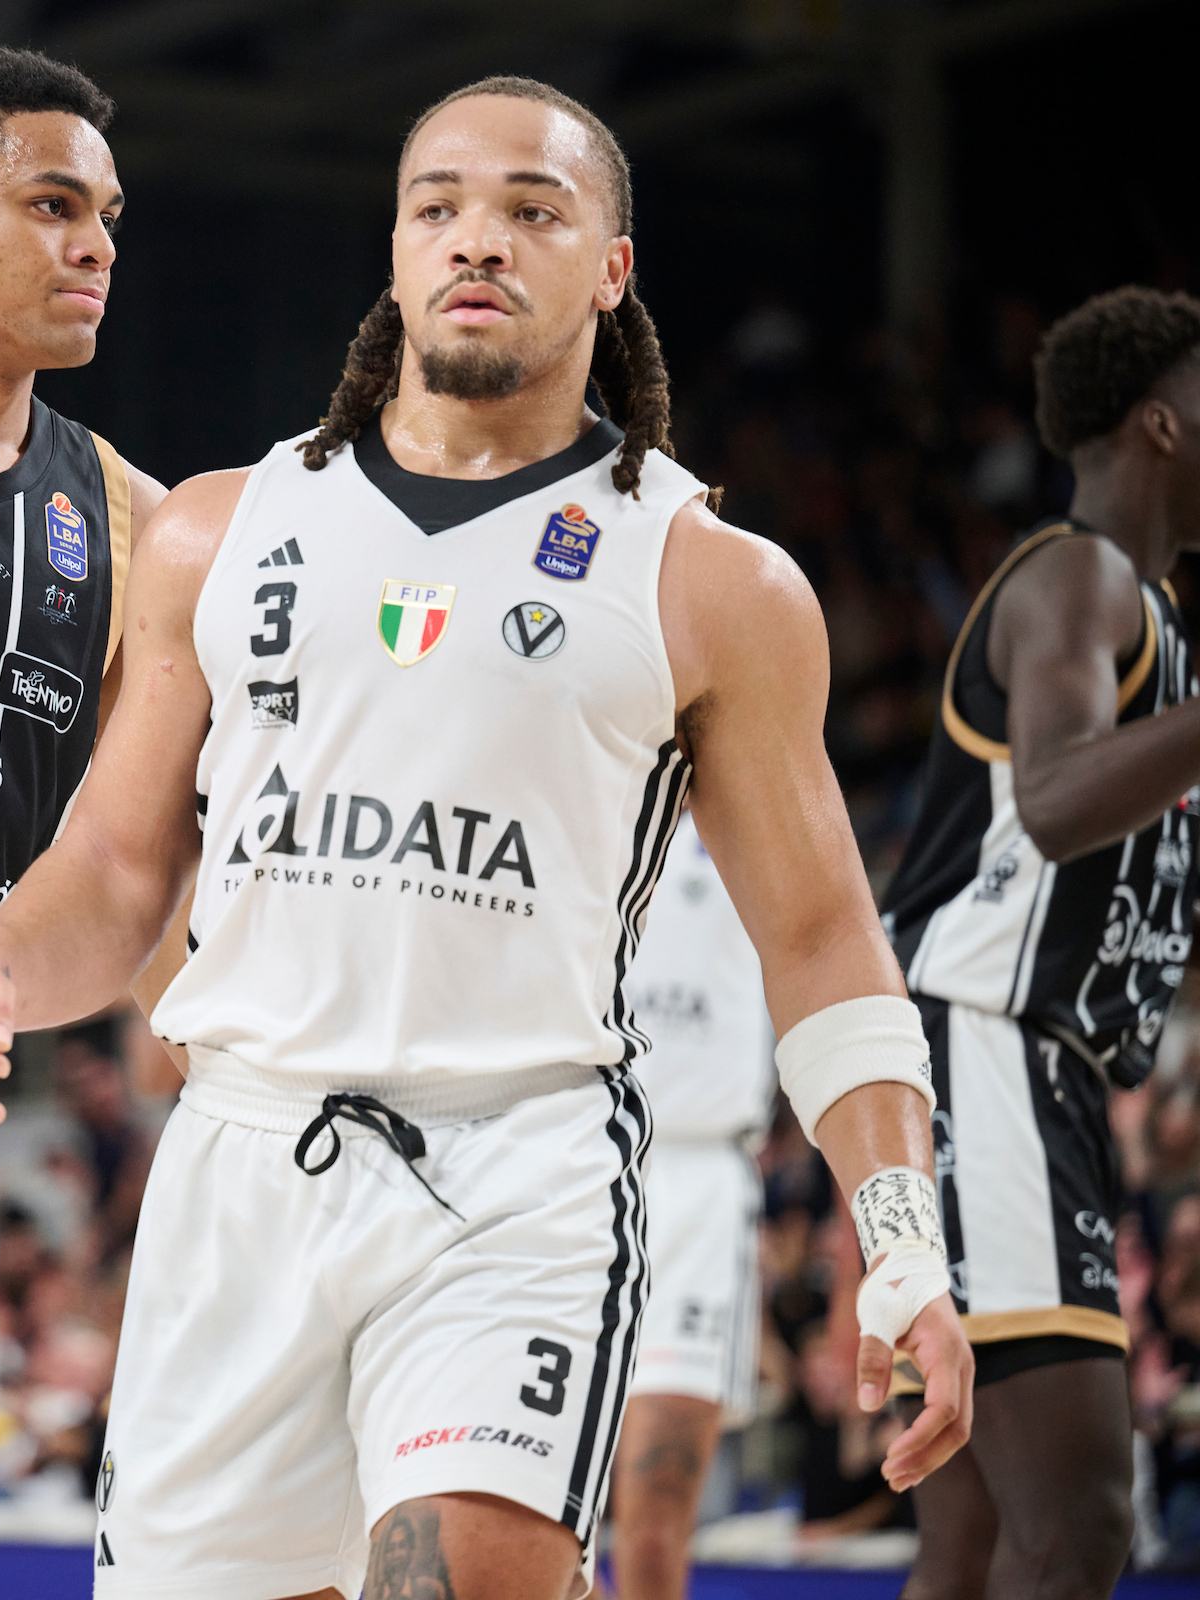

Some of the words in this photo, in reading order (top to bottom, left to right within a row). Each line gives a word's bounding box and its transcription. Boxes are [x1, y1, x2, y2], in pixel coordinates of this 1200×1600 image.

[53, 524, 83, 548] LBA
[548, 530, 588, 554] LBA
[58, 552, 82, 571] Unipol
[545, 556, 580, 574] Unipol
[400, 587, 437, 602] FIP
[250, 582, 298, 657] 3
[224, 879, 242, 893] TH
[255, 868, 333, 886] POWER
[353, 875, 381, 890] OF
[400, 880, 534, 917] PIONEERS
[520, 1337, 572, 1416] 3
